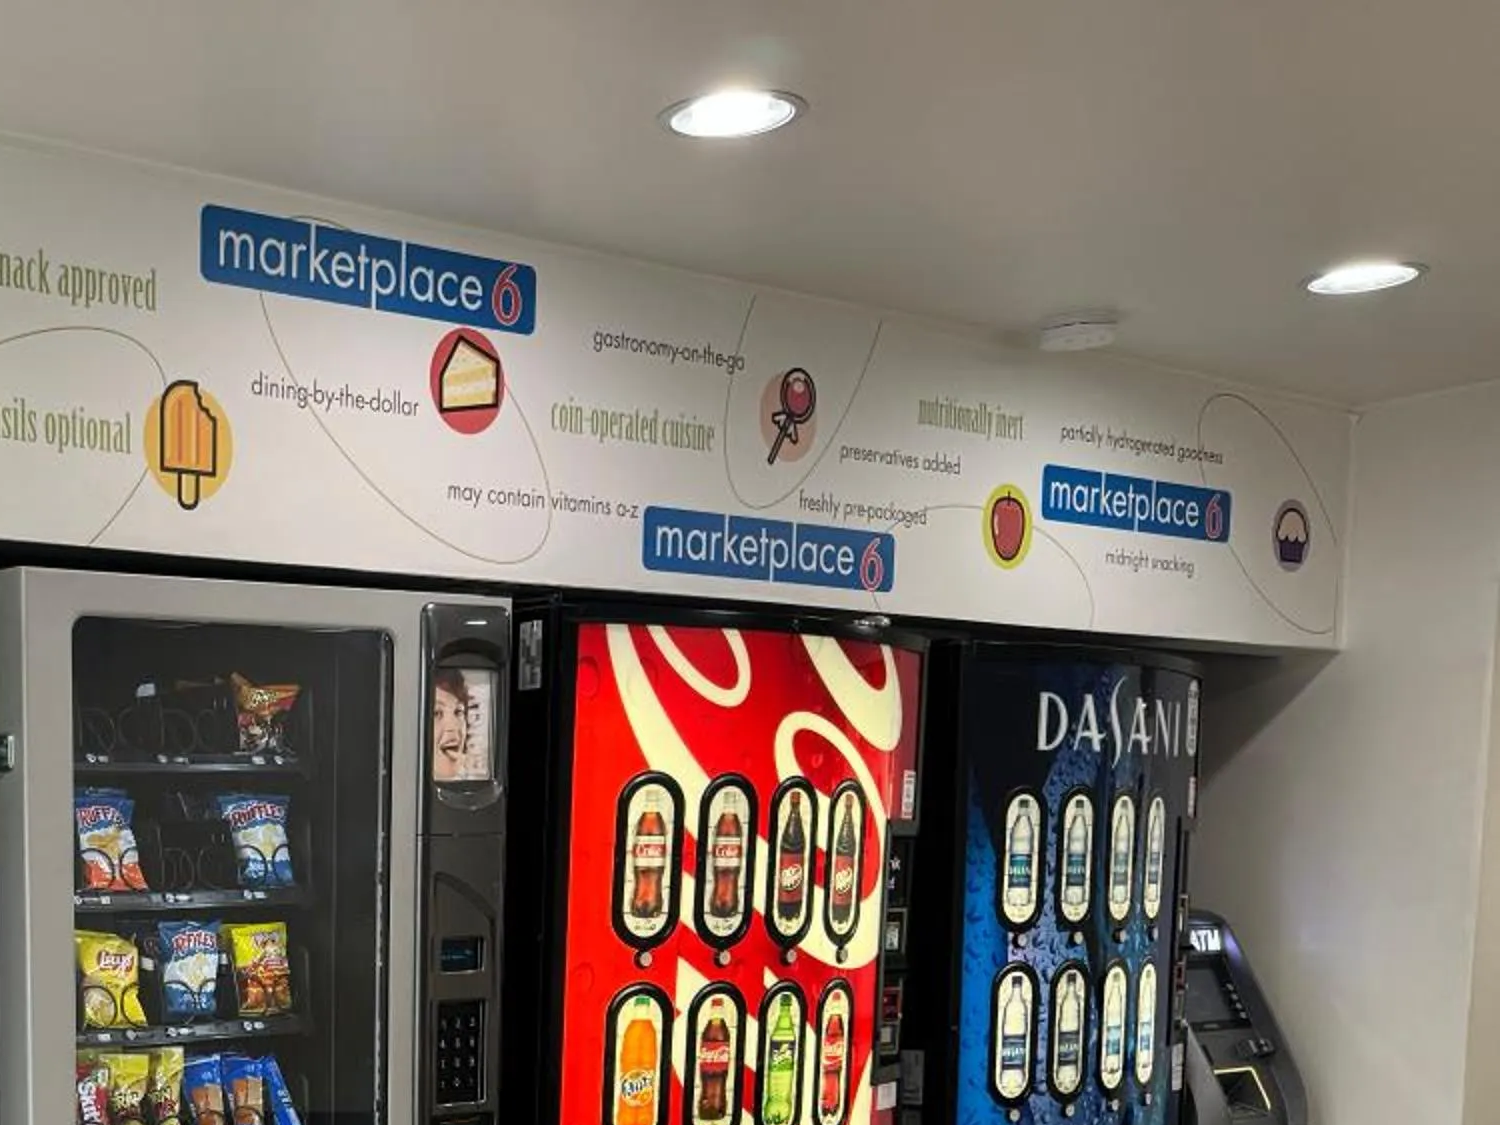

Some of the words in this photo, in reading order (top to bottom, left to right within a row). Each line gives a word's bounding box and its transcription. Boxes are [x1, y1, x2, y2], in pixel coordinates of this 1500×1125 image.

[59, 256, 157, 312] approved
[219, 222, 483, 310] marketplace
[491, 264, 523, 325] 6
[593, 329, 745, 374] gastronomy-on-the-go
[251, 372, 420, 418] dining-by-the-dollar
[918, 395, 992, 440] nutritionally
[996, 405, 1024, 441] inert
[45, 406, 132, 454] optional
[551, 398, 658, 447] coin-operated
[662, 417, 715, 452] cuisine
[1061, 425, 1103, 449] partially
[1107, 427, 1175, 458] hydrogenated
[1177, 443, 1223, 465] goodness
[840, 444, 919, 470] preservatives
[923, 451, 961, 475] added
[448, 482, 483, 506] may
[488, 486, 545, 509] contain
[550, 493, 611, 517] vitamins
[616, 501, 639, 519] a-z
[799, 489, 840, 518] freshly
[844, 502, 927, 528] pre-packaged
[1050, 471, 1199, 532] marketplace
[1205, 494, 1223, 539] 6
[656, 514, 854, 582] marketplace
[860, 537, 884, 592] 6
[1105, 549, 1150, 574] midnight
[1037, 676, 1181, 769] DASANI
